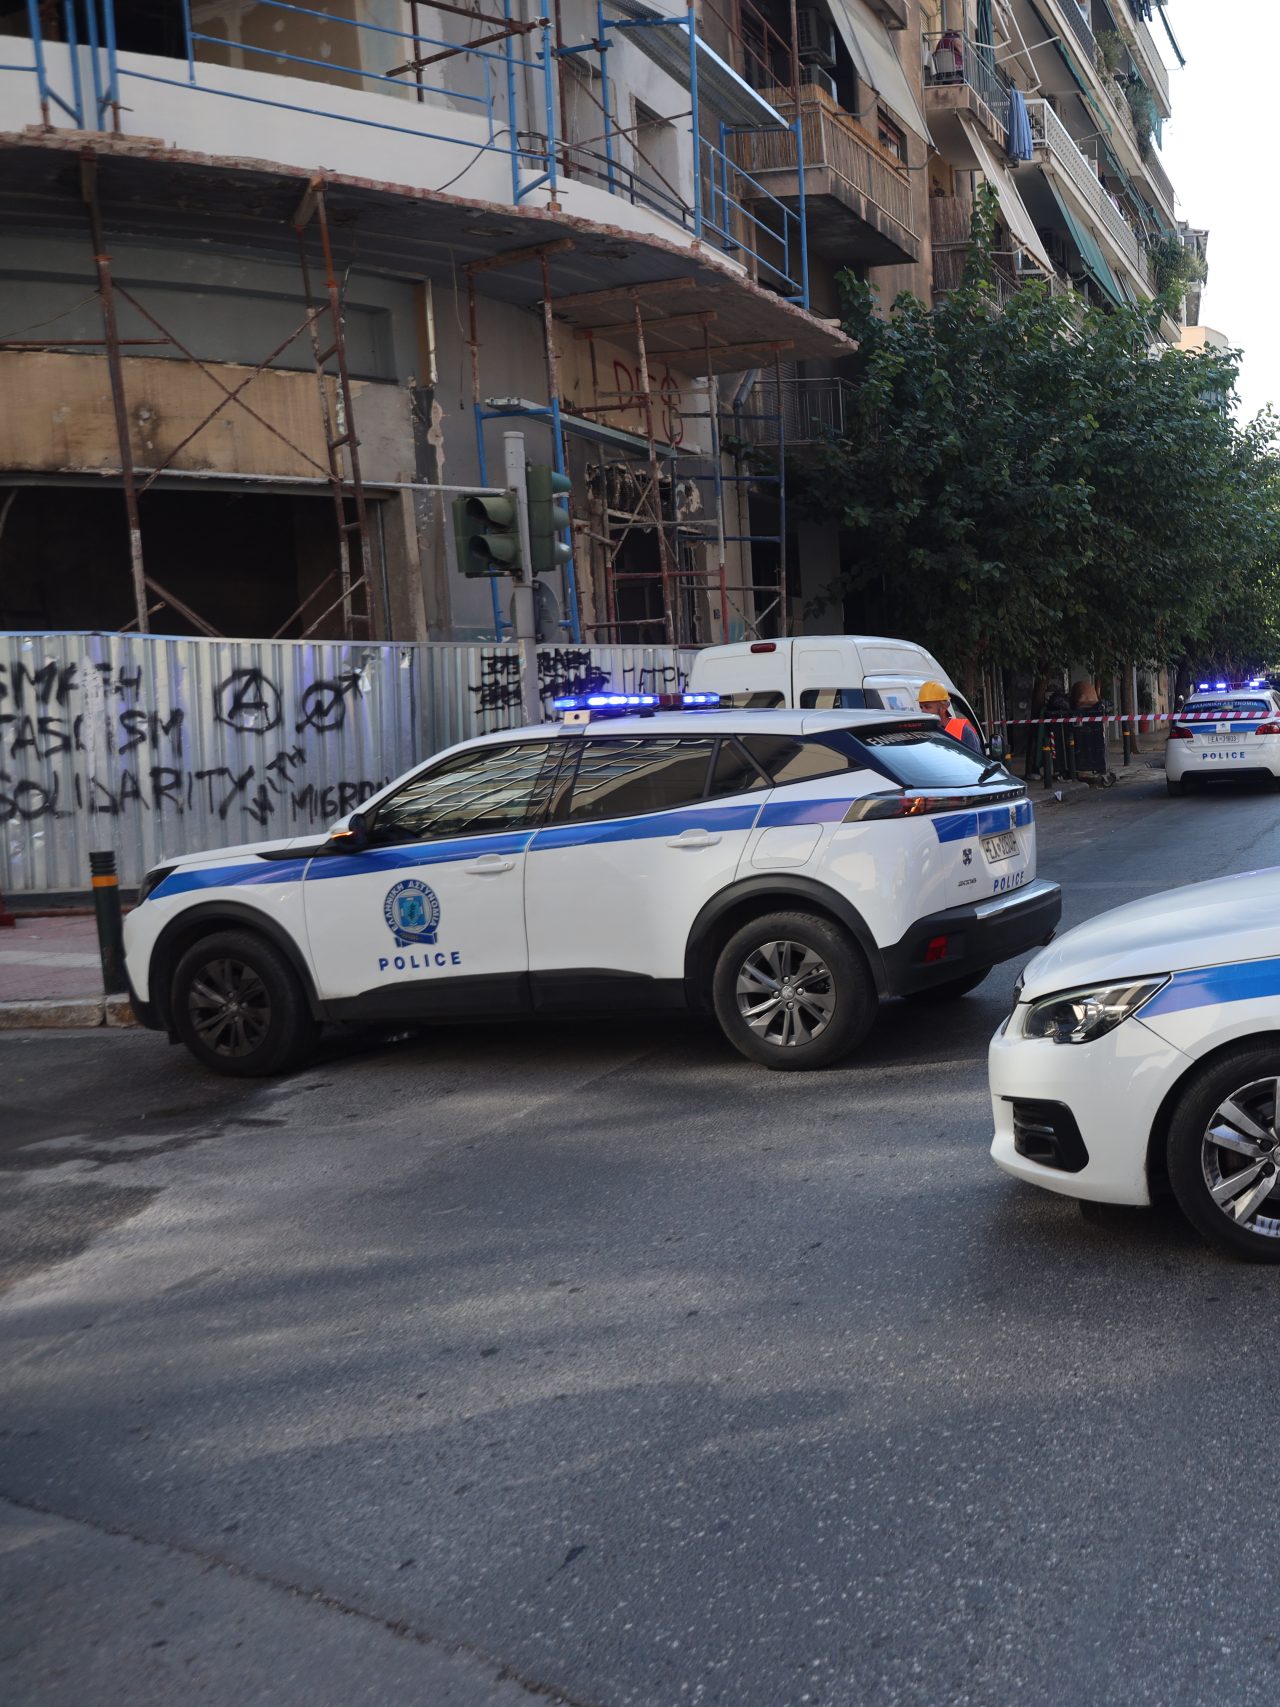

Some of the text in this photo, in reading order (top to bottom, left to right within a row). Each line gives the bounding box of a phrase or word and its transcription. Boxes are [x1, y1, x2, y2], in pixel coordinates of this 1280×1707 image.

[1202, 751, 1246, 761] POLICE
[993, 870, 1025, 892] POLICE
[384, 880, 440, 932] ΕΛΛΗΝΙΚΗ ΑΣΤΥΝΟΜΙΑ
[378, 951, 462, 972] POLICE
